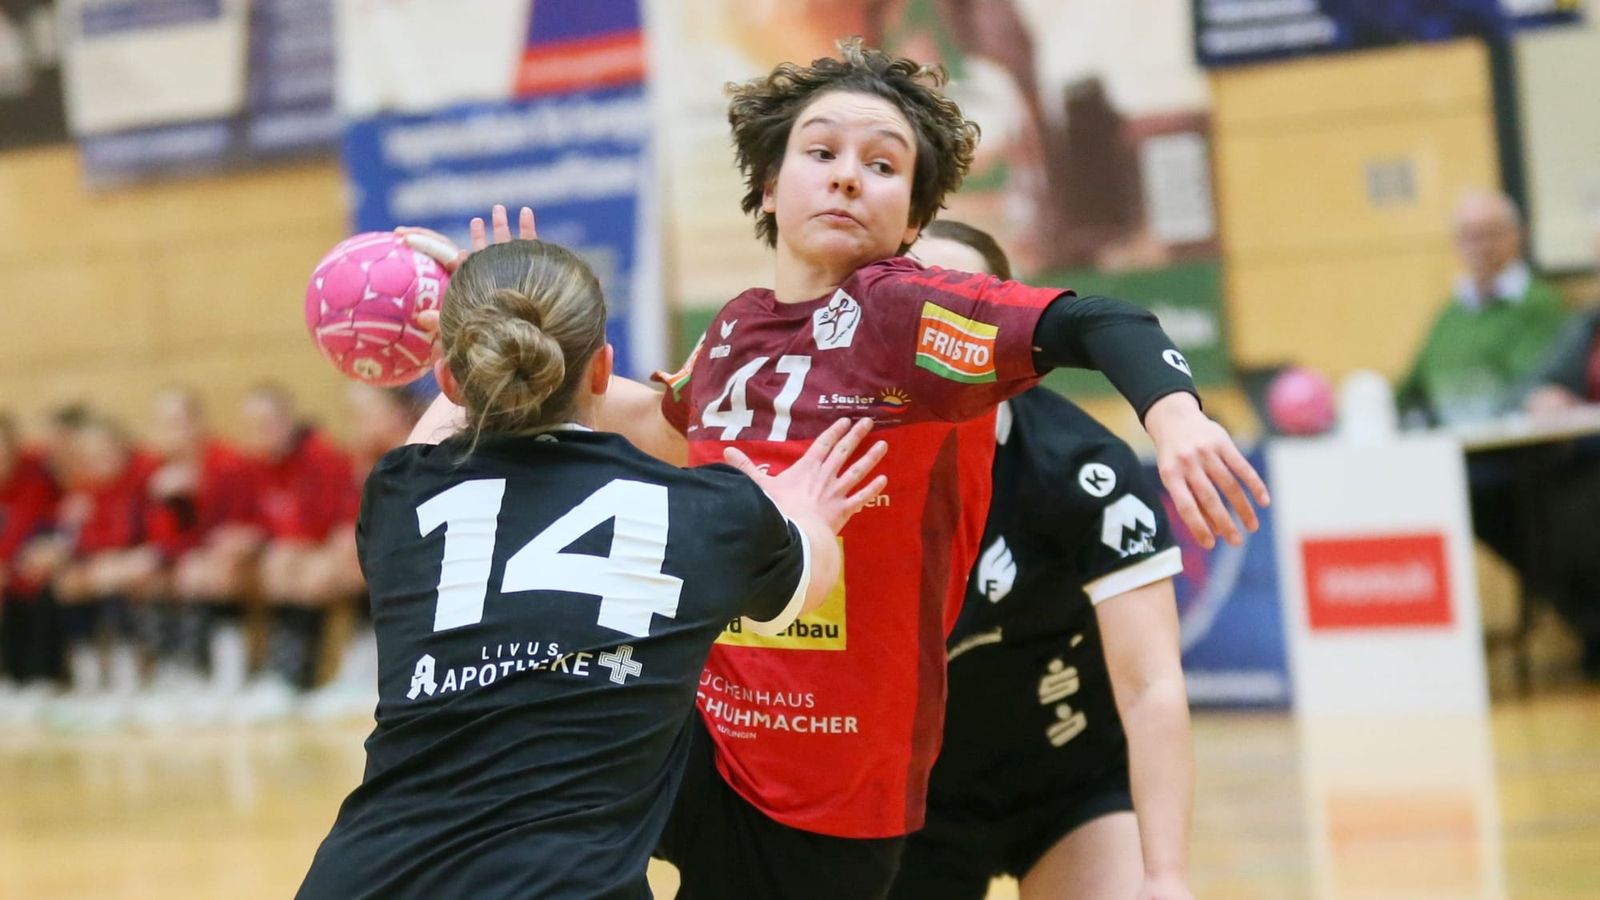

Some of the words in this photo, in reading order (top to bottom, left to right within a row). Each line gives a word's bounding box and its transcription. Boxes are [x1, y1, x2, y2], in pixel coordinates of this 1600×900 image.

[922, 326, 989, 367] FRISTO
[702, 355, 812, 442] 47
[416, 478, 684, 638] 14
[482, 642, 560, 661] LIVUS
